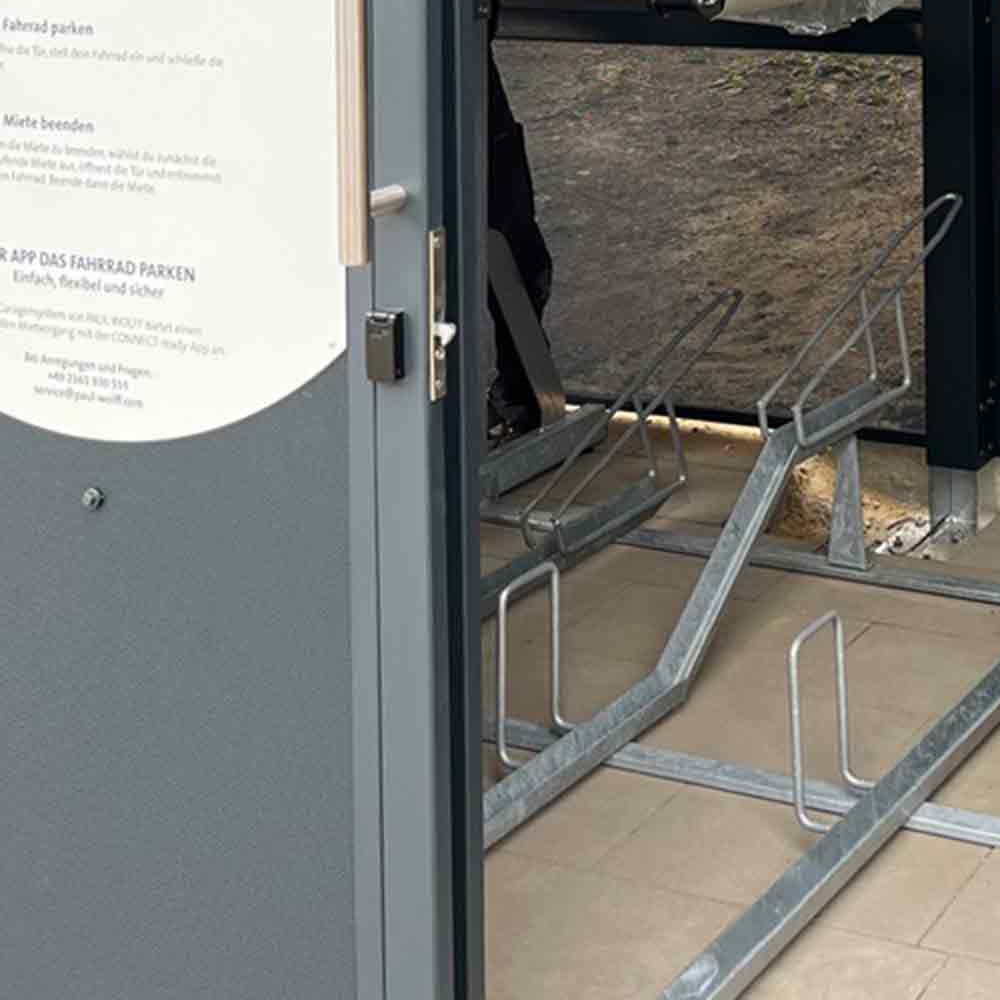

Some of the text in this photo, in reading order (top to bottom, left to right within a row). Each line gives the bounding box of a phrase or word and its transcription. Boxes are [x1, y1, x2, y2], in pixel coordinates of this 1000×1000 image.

[2, 16, 94, 37] Fahrrad parken
[3, 113, 94, 134] Miete beenden
[10, 248, 36, 265] APP
[39, 251, 67, 269] DAS
[70, 254, 136, 276] FAHRRAD
[140, 261, 196, 282] PARKEN
[13, 269, 164, 299] Einfach, flexibel und sicher
